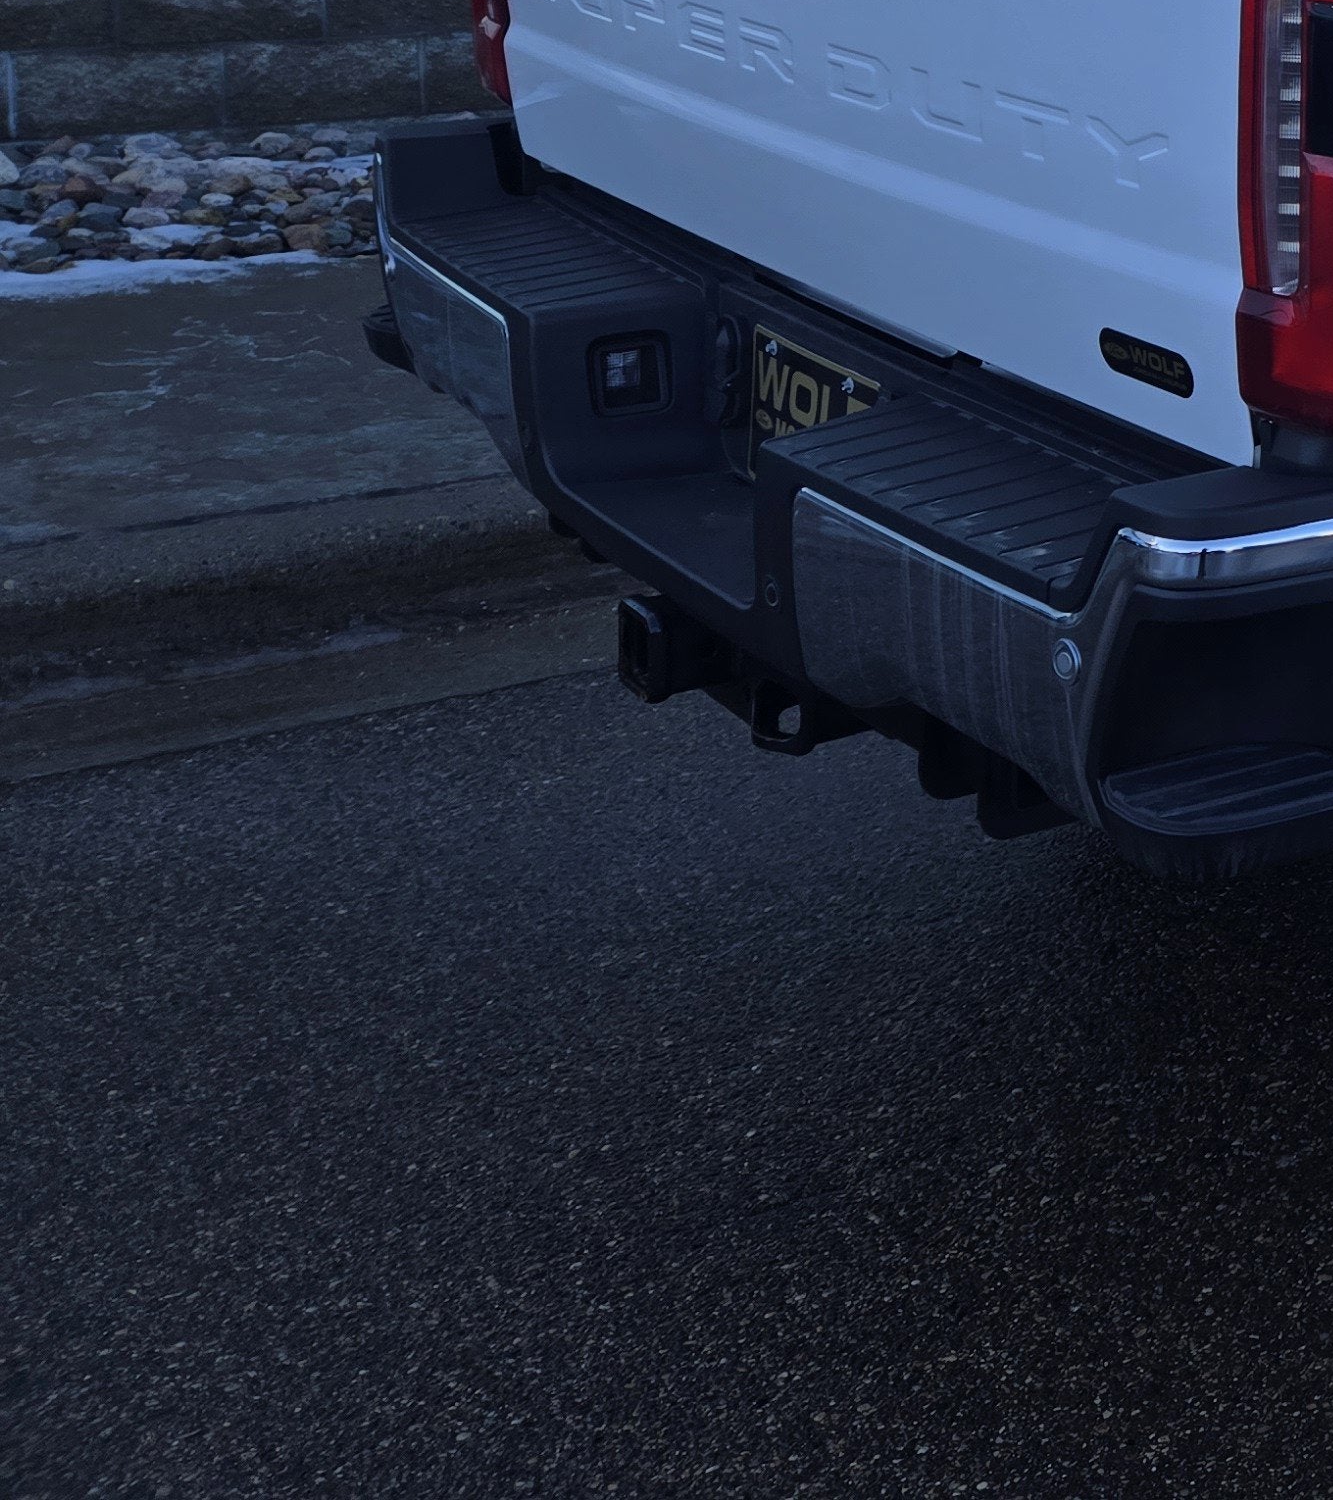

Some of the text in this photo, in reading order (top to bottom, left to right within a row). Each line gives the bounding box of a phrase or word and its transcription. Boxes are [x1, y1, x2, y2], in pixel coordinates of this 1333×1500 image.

[825, 40, 1171, 190] DUTY
[758, 350, 872, 429] WOL
[1129, 344, 1186, 379] WOLF
